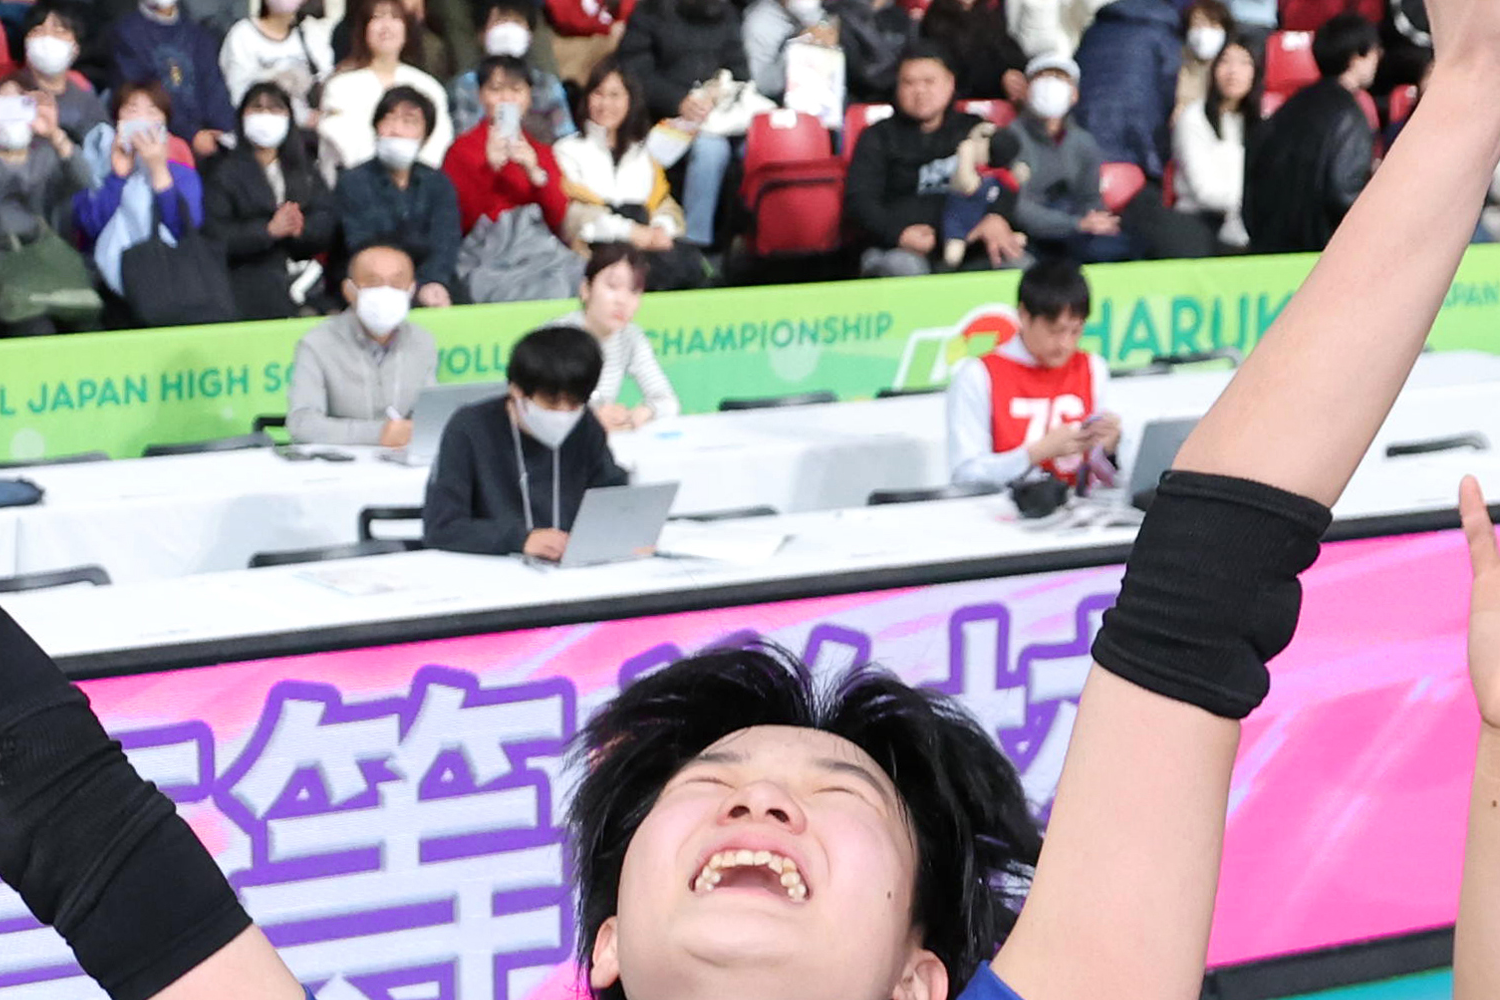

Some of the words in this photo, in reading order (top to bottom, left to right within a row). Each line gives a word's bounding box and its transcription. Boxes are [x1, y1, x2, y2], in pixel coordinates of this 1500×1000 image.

[1083, 290, 1296, 362] HARUK
[26, 374, 149, 416] JAPAN
[159, 363, 250, 402] HIGH
